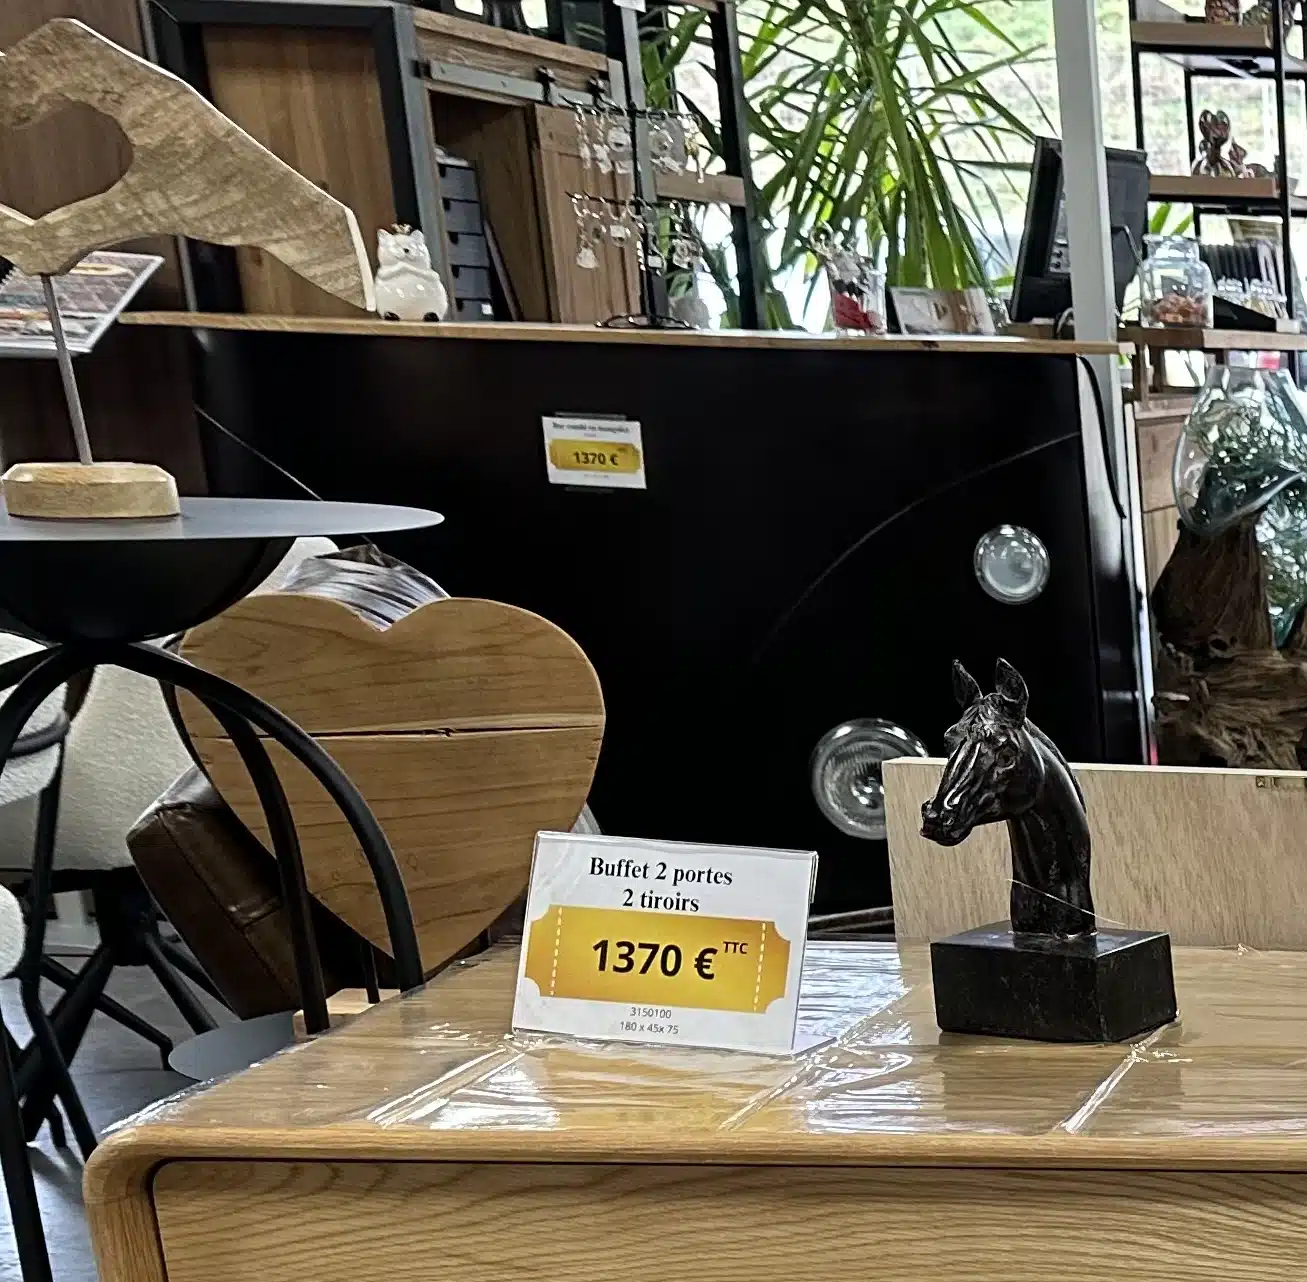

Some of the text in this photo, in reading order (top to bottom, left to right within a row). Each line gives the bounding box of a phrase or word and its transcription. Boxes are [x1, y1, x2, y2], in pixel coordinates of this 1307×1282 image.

[573, 450, 606, 465] 1370
[610, 453, 619, 466] €
[590, 857, 733, 886] Buffet 2 portes
[622, 888, 700, 912] 2 tiroirs
[592, 939, 748, 980] 1370 € TTC
[629, 1006, 672, 1019] 3150100
[620, 1021, 637, 1032] 180
[667, 1025, 679, 1035] 75
